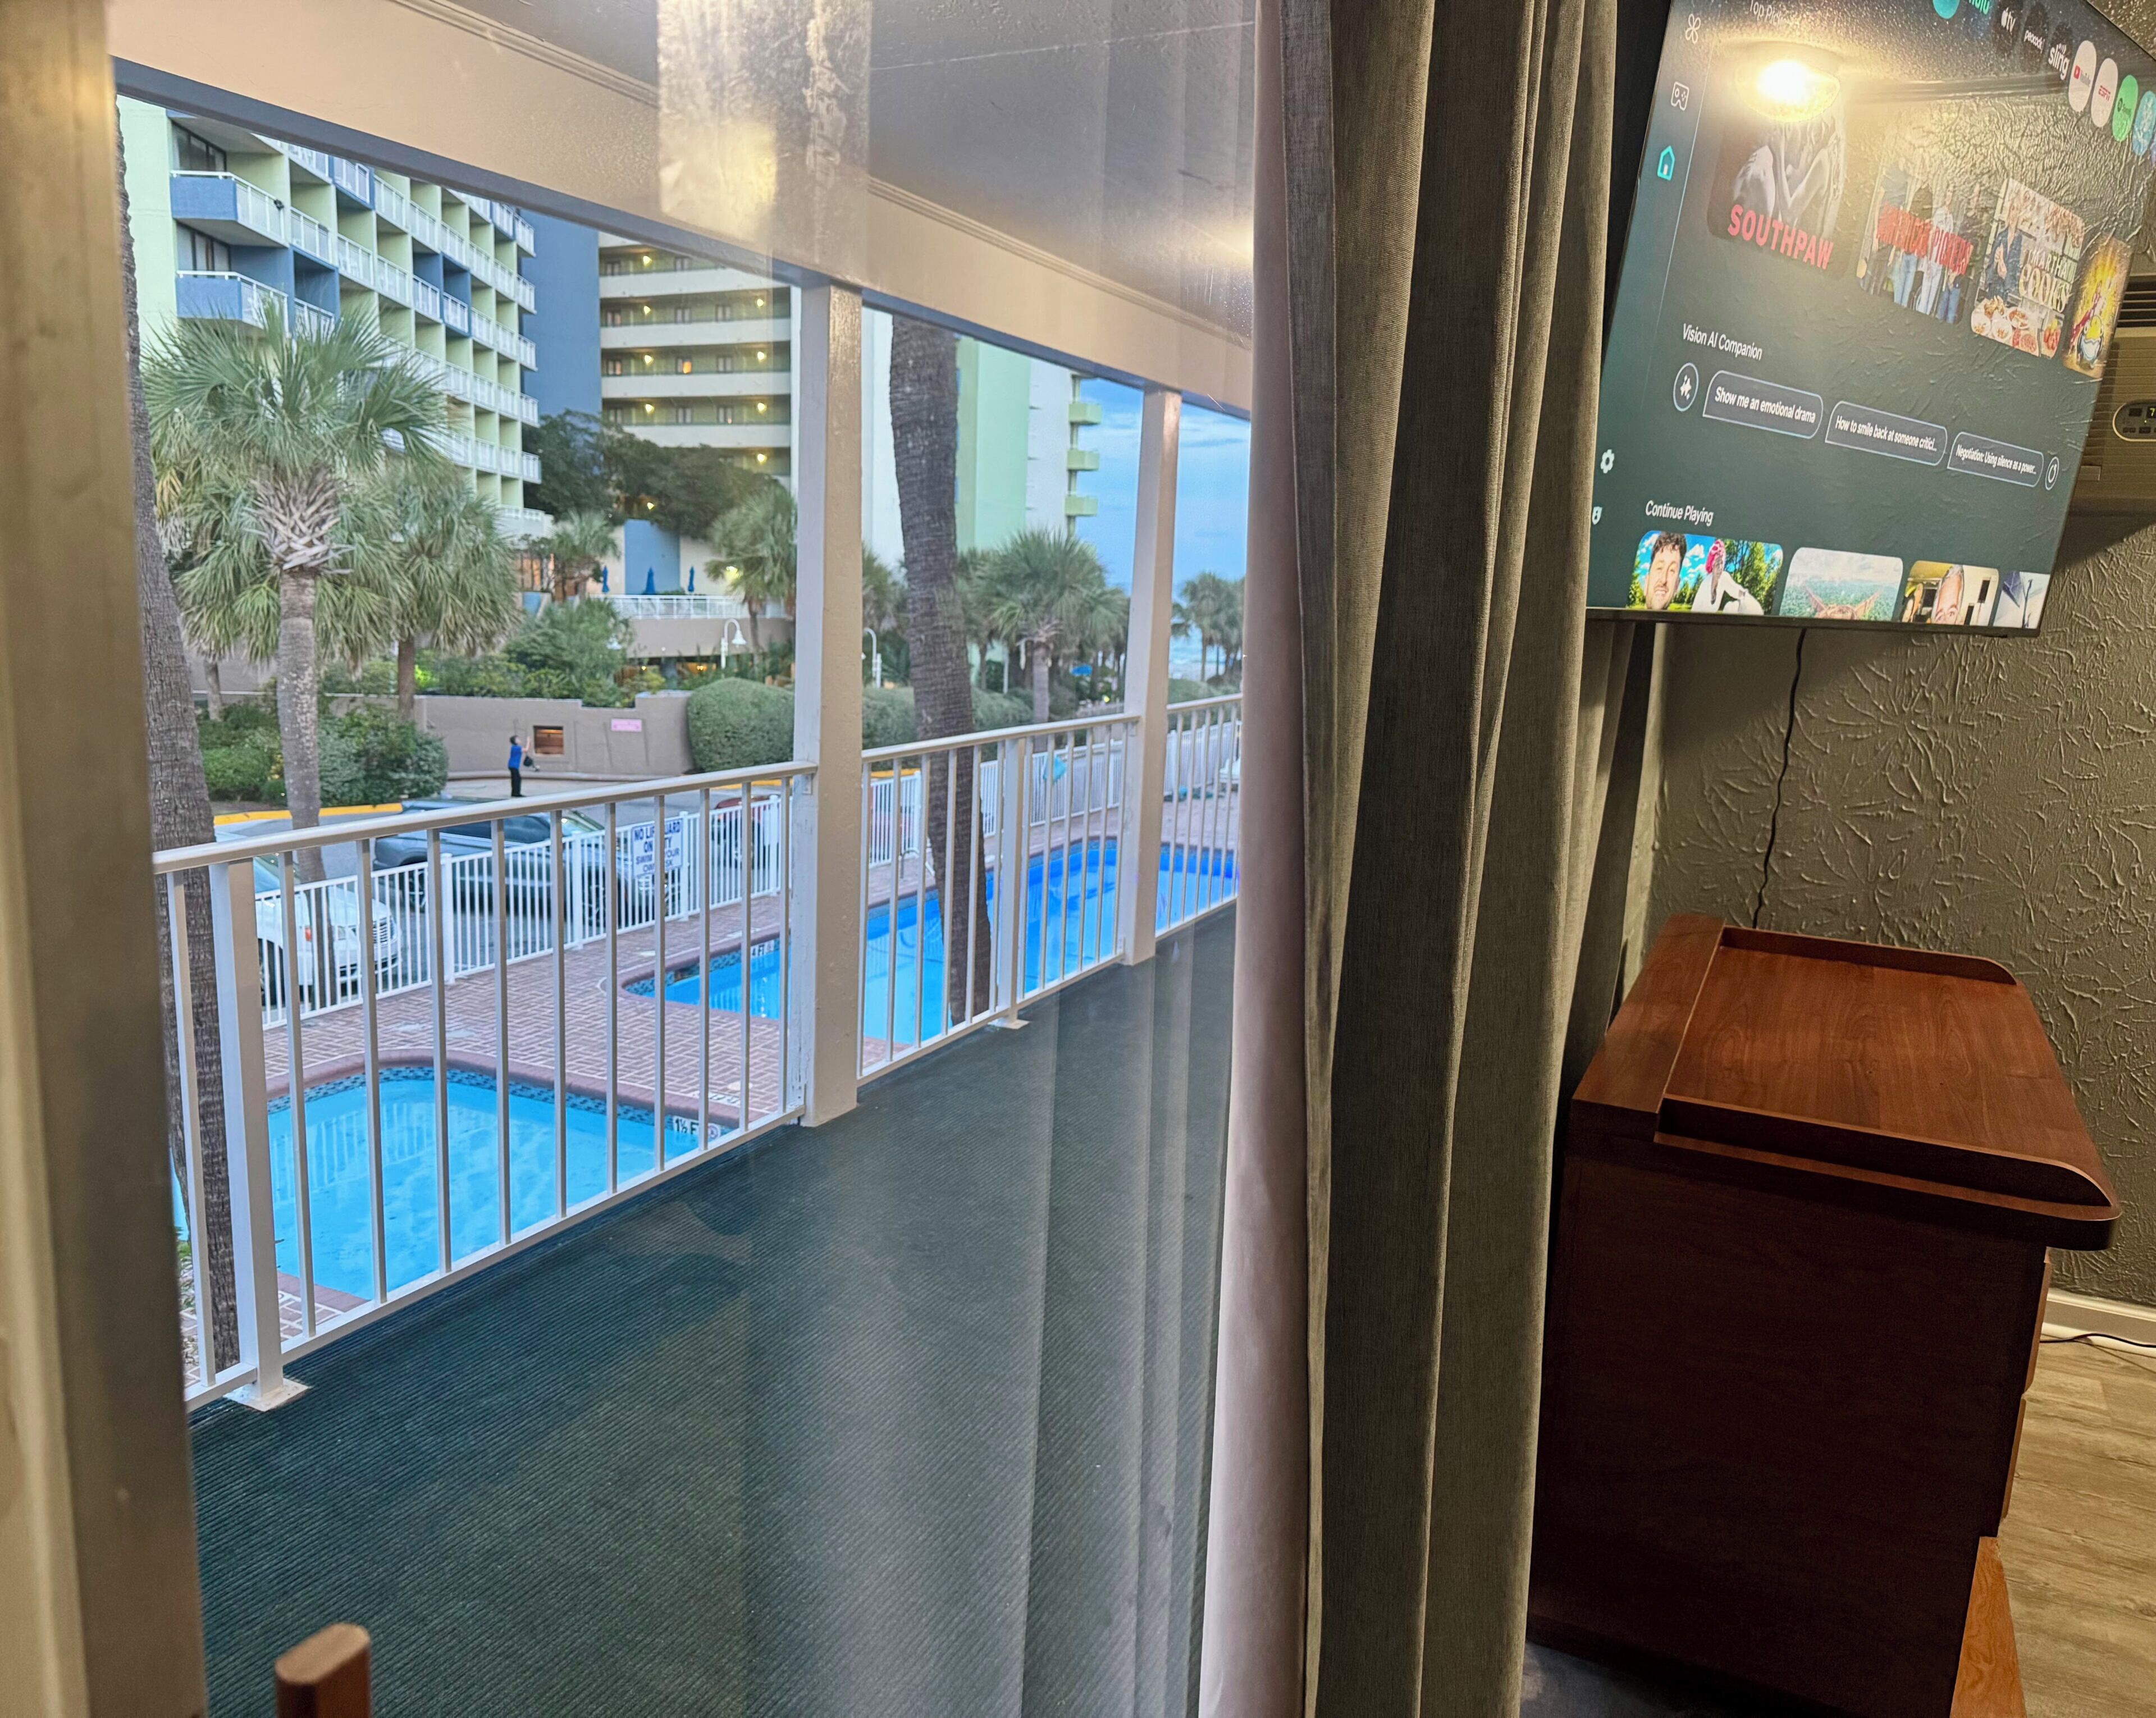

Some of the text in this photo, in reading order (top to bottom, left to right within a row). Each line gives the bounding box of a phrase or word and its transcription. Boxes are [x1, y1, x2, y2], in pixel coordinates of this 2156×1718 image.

[2048, 44, 2070, 80] sling
[1727, 204, 1834, 270] SOUTHPAW
[2019, 264, 2068, 313] COOKS
[1683, 323, 1762, 360] Vision AI Companion
[1715, 386, 1816, 424] Show me an emotional drama
[1835, 415, 1851, 431] How
[1850, 420, 1857, 433] to
[1857, 423, 1874, 437] smile
[1873, 424, 1887, 440] back
[1887, 430, 1894, 442] at
[1894, 432, 1919, 447] someone
[1956, 444, 1985, 462] Negotiation:
[1984, 451, 1998, 468] Using
[1997, 455, 2013, 469] silence
[2012, 460, 2018, 470] as
[2018, 462, 2022, 472] a
[1645, 500, 1714, 527] Continue Playing
[634, 828, 643, 841] NO
